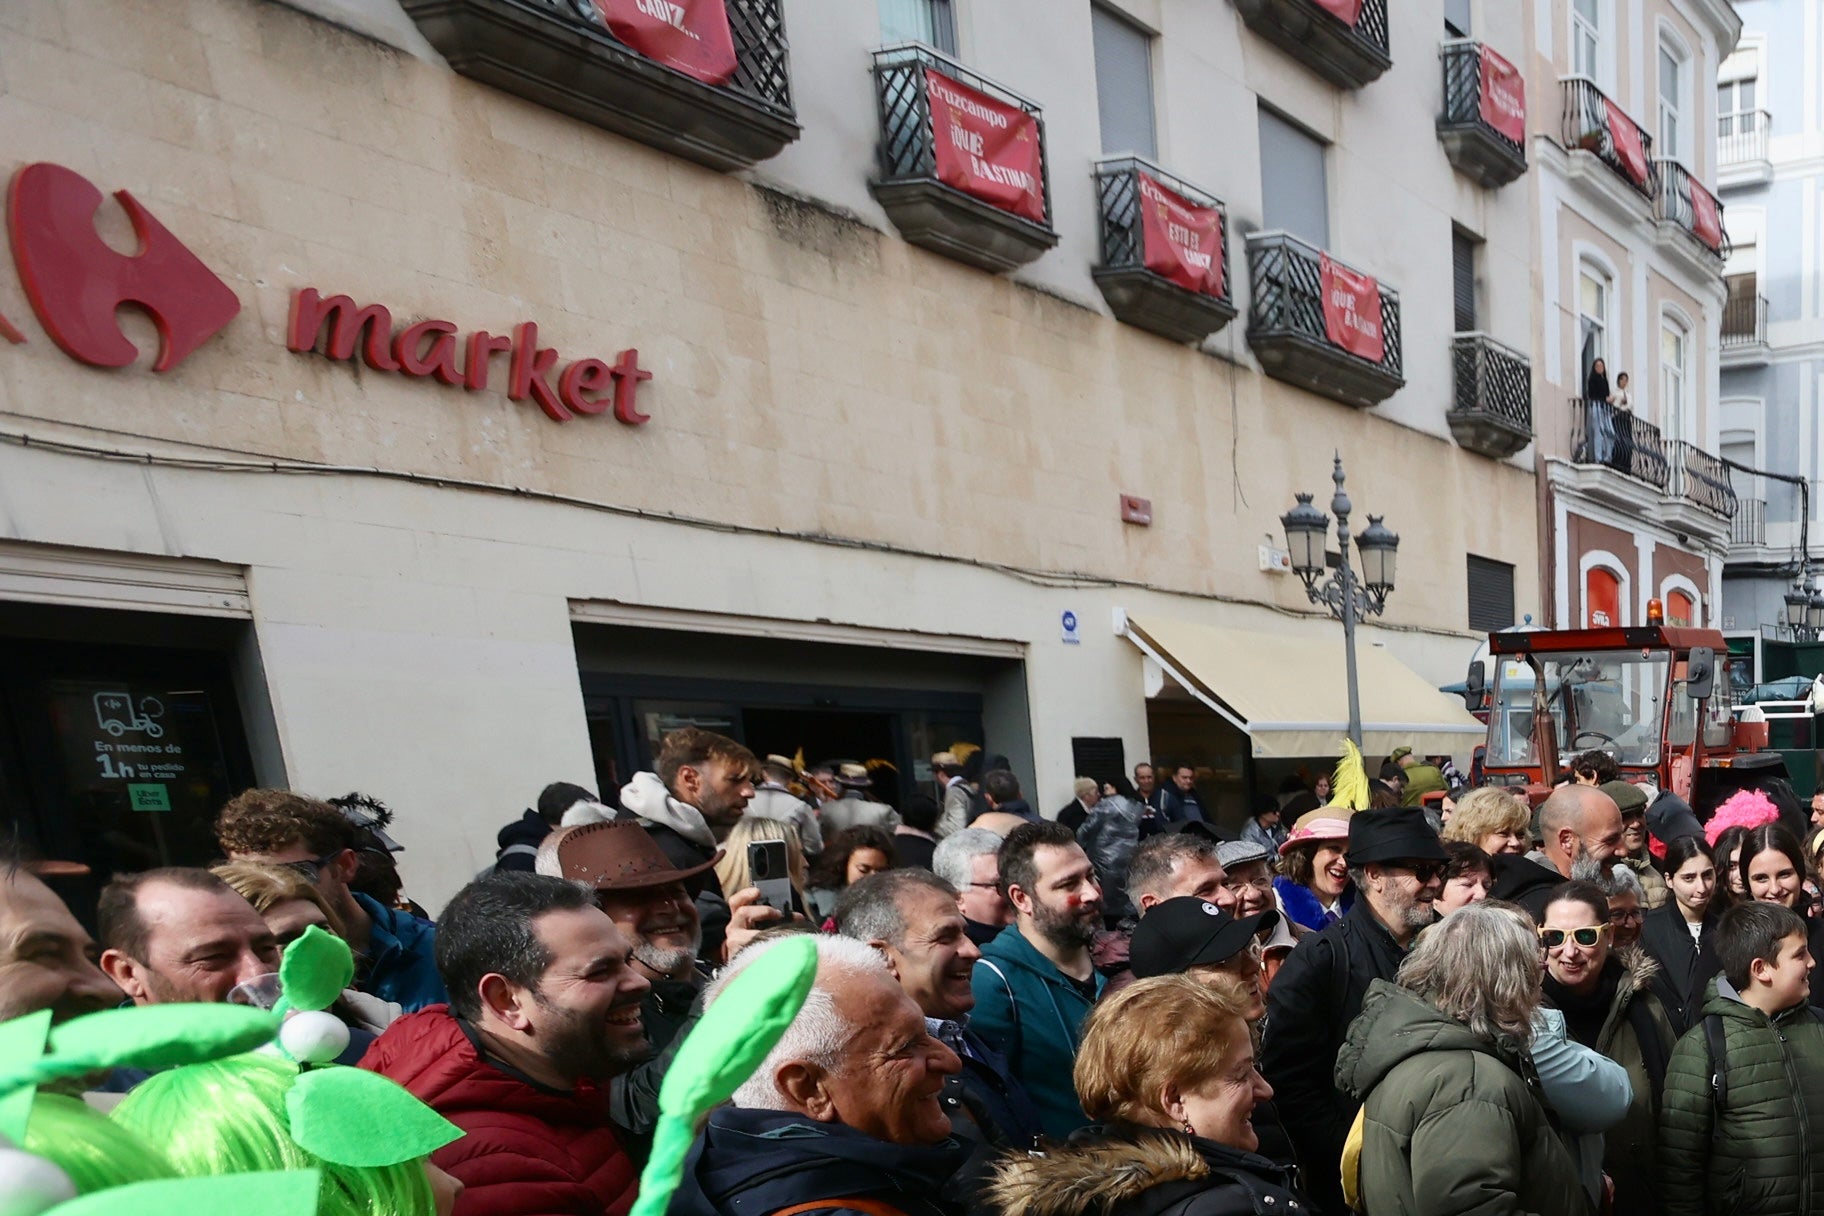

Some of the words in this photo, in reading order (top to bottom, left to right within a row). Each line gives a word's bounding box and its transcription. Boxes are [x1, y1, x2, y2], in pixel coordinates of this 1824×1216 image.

[929, 79, 1007, 130] Cruzcampo
[287, 287, 653, 425] market
[94, 741, 113, 752] En
[116, 743, 162, 754] menos
[165, 744, 182, 754] de
[96, 753, 135, 778] 1h
[137, 763, 149, 771] tu
[151, 763, 184, 772] pedido
